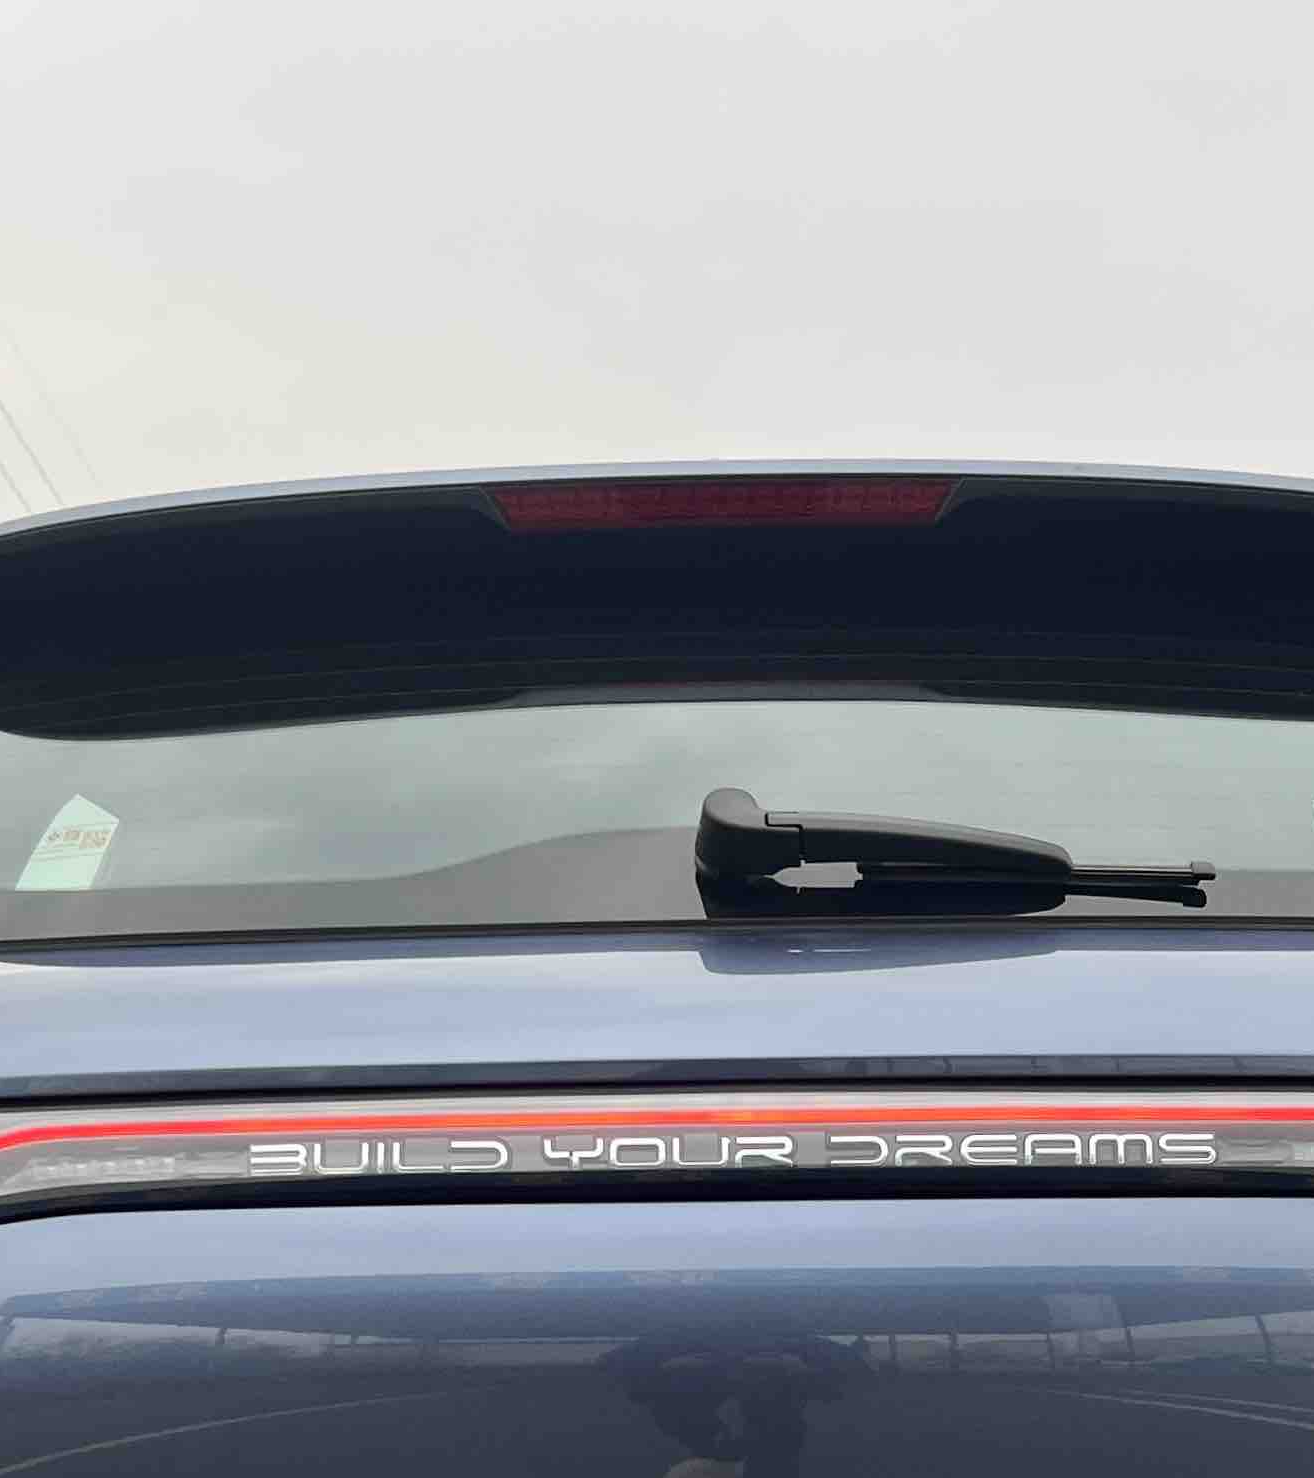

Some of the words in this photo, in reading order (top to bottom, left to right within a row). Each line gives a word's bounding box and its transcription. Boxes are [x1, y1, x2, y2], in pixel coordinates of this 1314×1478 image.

[250, 1139, 509, 1176] BUILD
[543, 1136, 794, 1169] YOUR
[829, 1133, 1217, 1165] DREAMS
